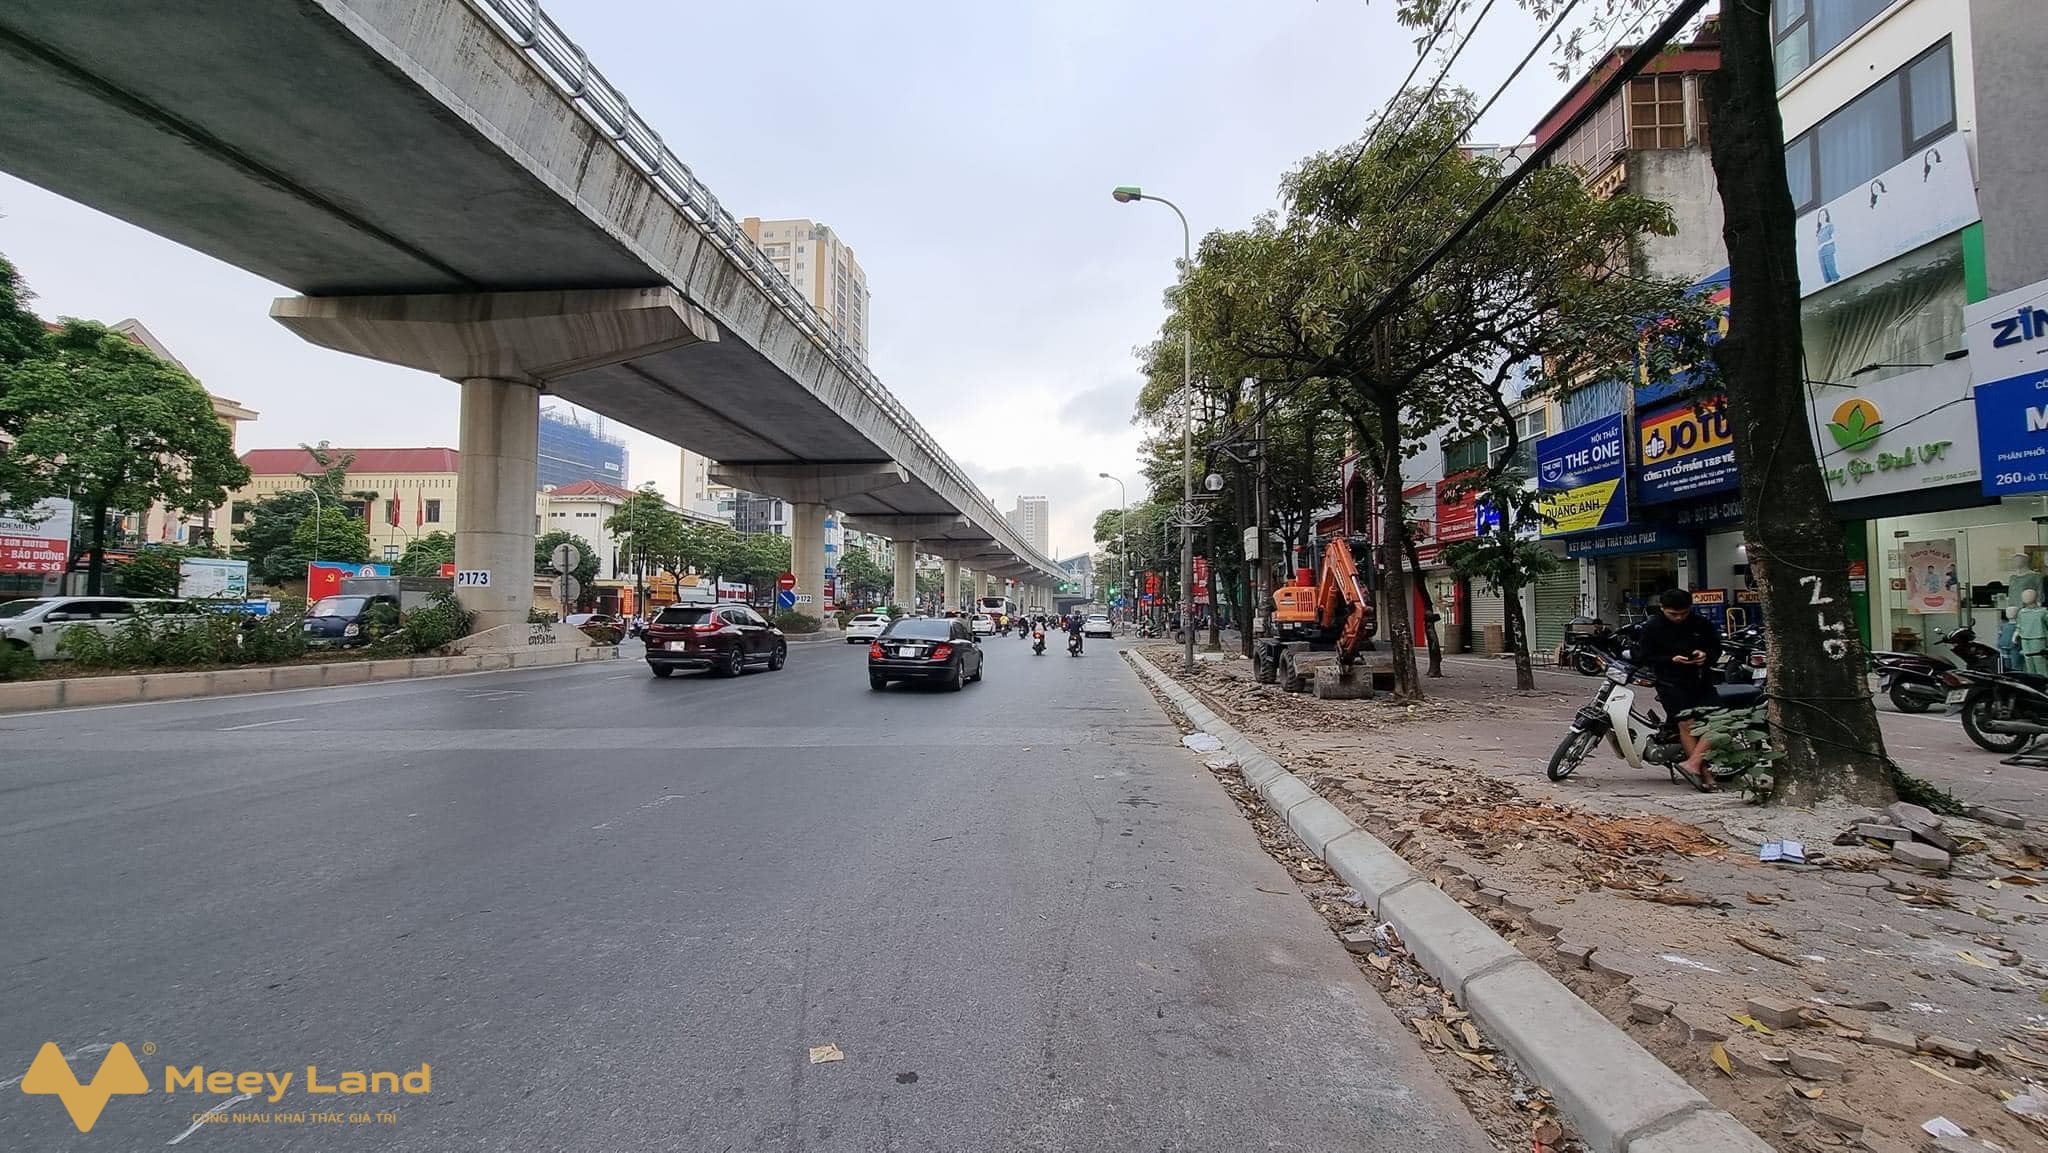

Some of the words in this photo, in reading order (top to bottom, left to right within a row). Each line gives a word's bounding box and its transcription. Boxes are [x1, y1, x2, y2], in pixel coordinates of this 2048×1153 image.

[1668, 410, 1732, 455] JOTU
[1565, 449, 1589, 470] THE
[1592, 440, 1620, 462] ONE
[1662, 468, 1672, 478] TY
[1722, 450, 1736, 463] VIỆ
[1996, 472, 2021, 485] 260
[1579, 498, 1600, 514] ANH
[11, 547, 31, 559] BẢO
[33, 550, 64, 561] DƯỠNG
[17, 561, 36, 570] XE
[41, 561, 61, 571] SỐ
[458, 572, 488, 585] P173
[1701, 592, 1721, 601] JOTUN
